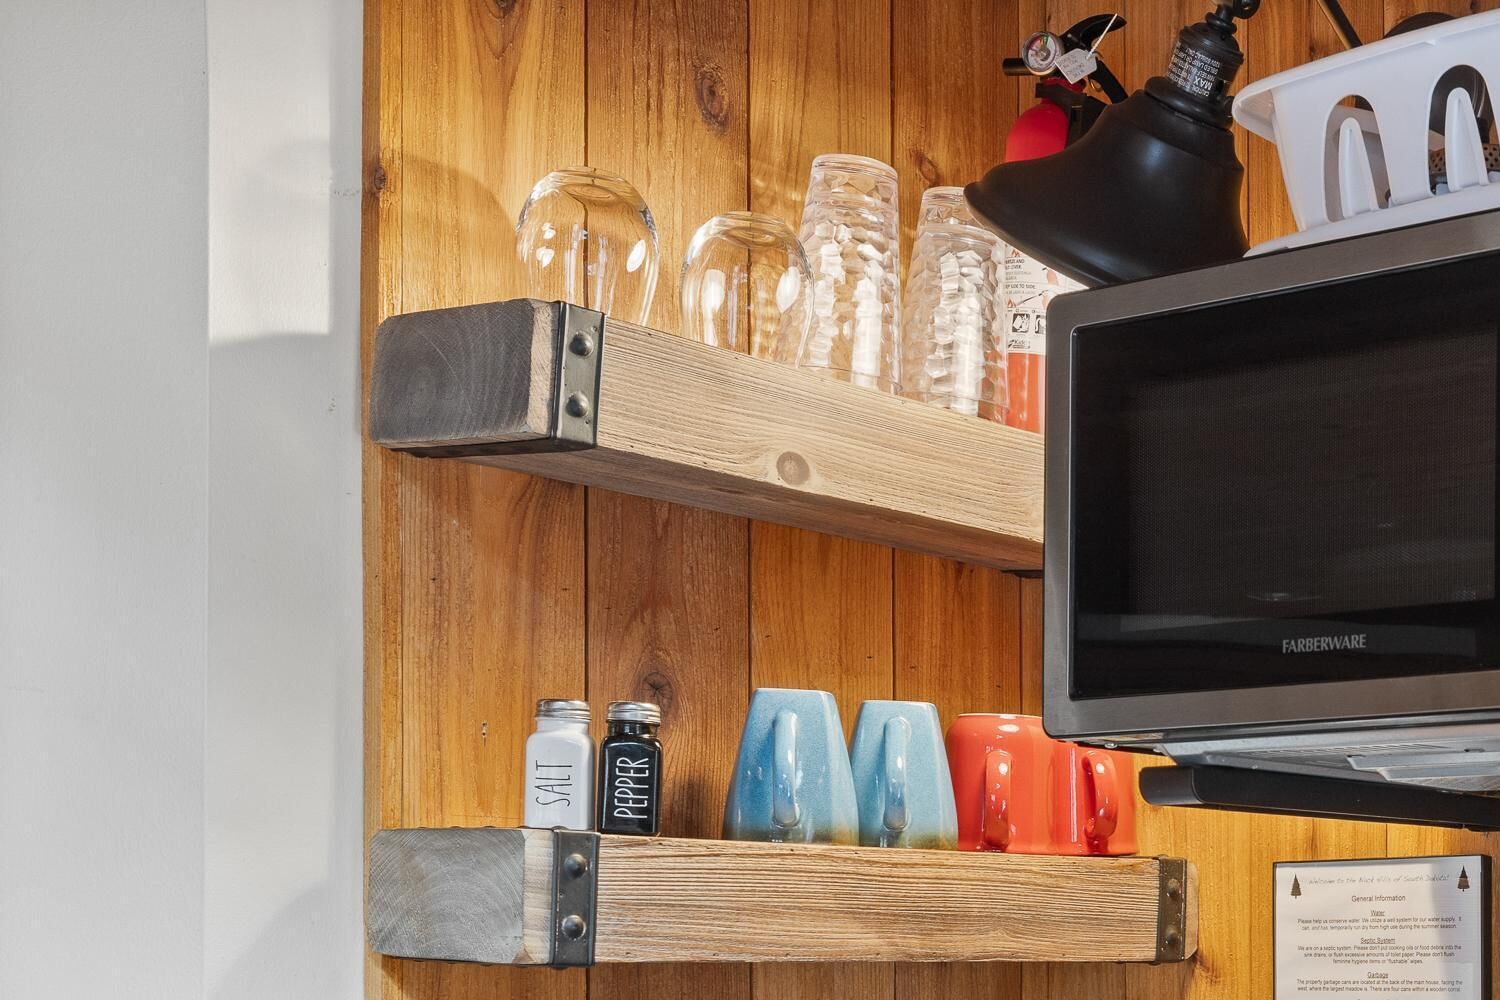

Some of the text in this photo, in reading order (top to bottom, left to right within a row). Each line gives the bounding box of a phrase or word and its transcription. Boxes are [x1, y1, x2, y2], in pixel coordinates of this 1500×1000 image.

[1194, 76, 1212, 90] MAX
[1282, 634, 1366, 654] FARBERWARE
[534, 760, 572, 807] SALT
[613, 757, 649, 818] PEPPER
